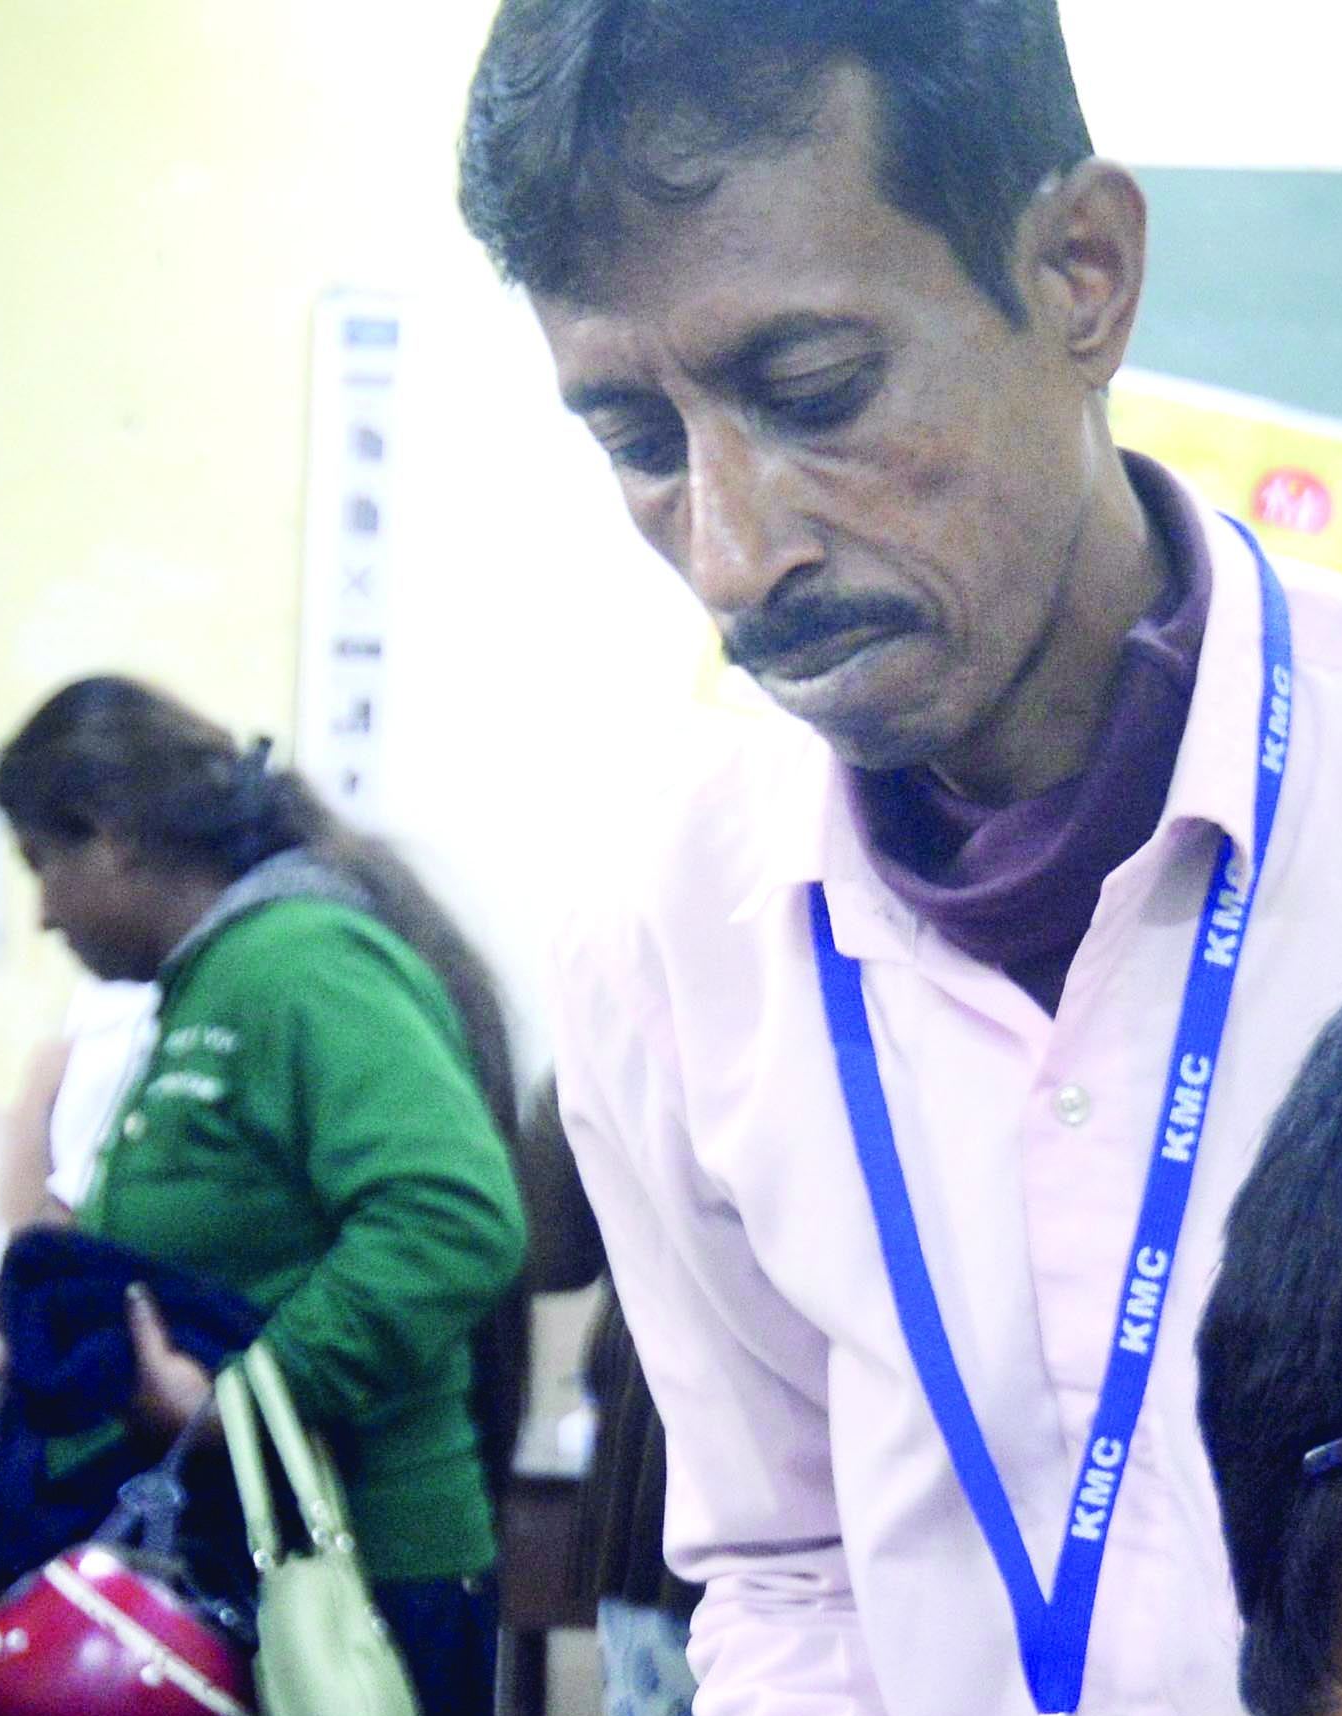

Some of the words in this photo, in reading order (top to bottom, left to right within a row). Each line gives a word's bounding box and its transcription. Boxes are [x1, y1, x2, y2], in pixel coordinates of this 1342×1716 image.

[1261, 664, 1290, 774] KMC
[1161, 1053, 1210, 1163] KMC
[1119, 1246, 1169, 1355] KMC
[1071, 1437, 1124, 1541] KMC
